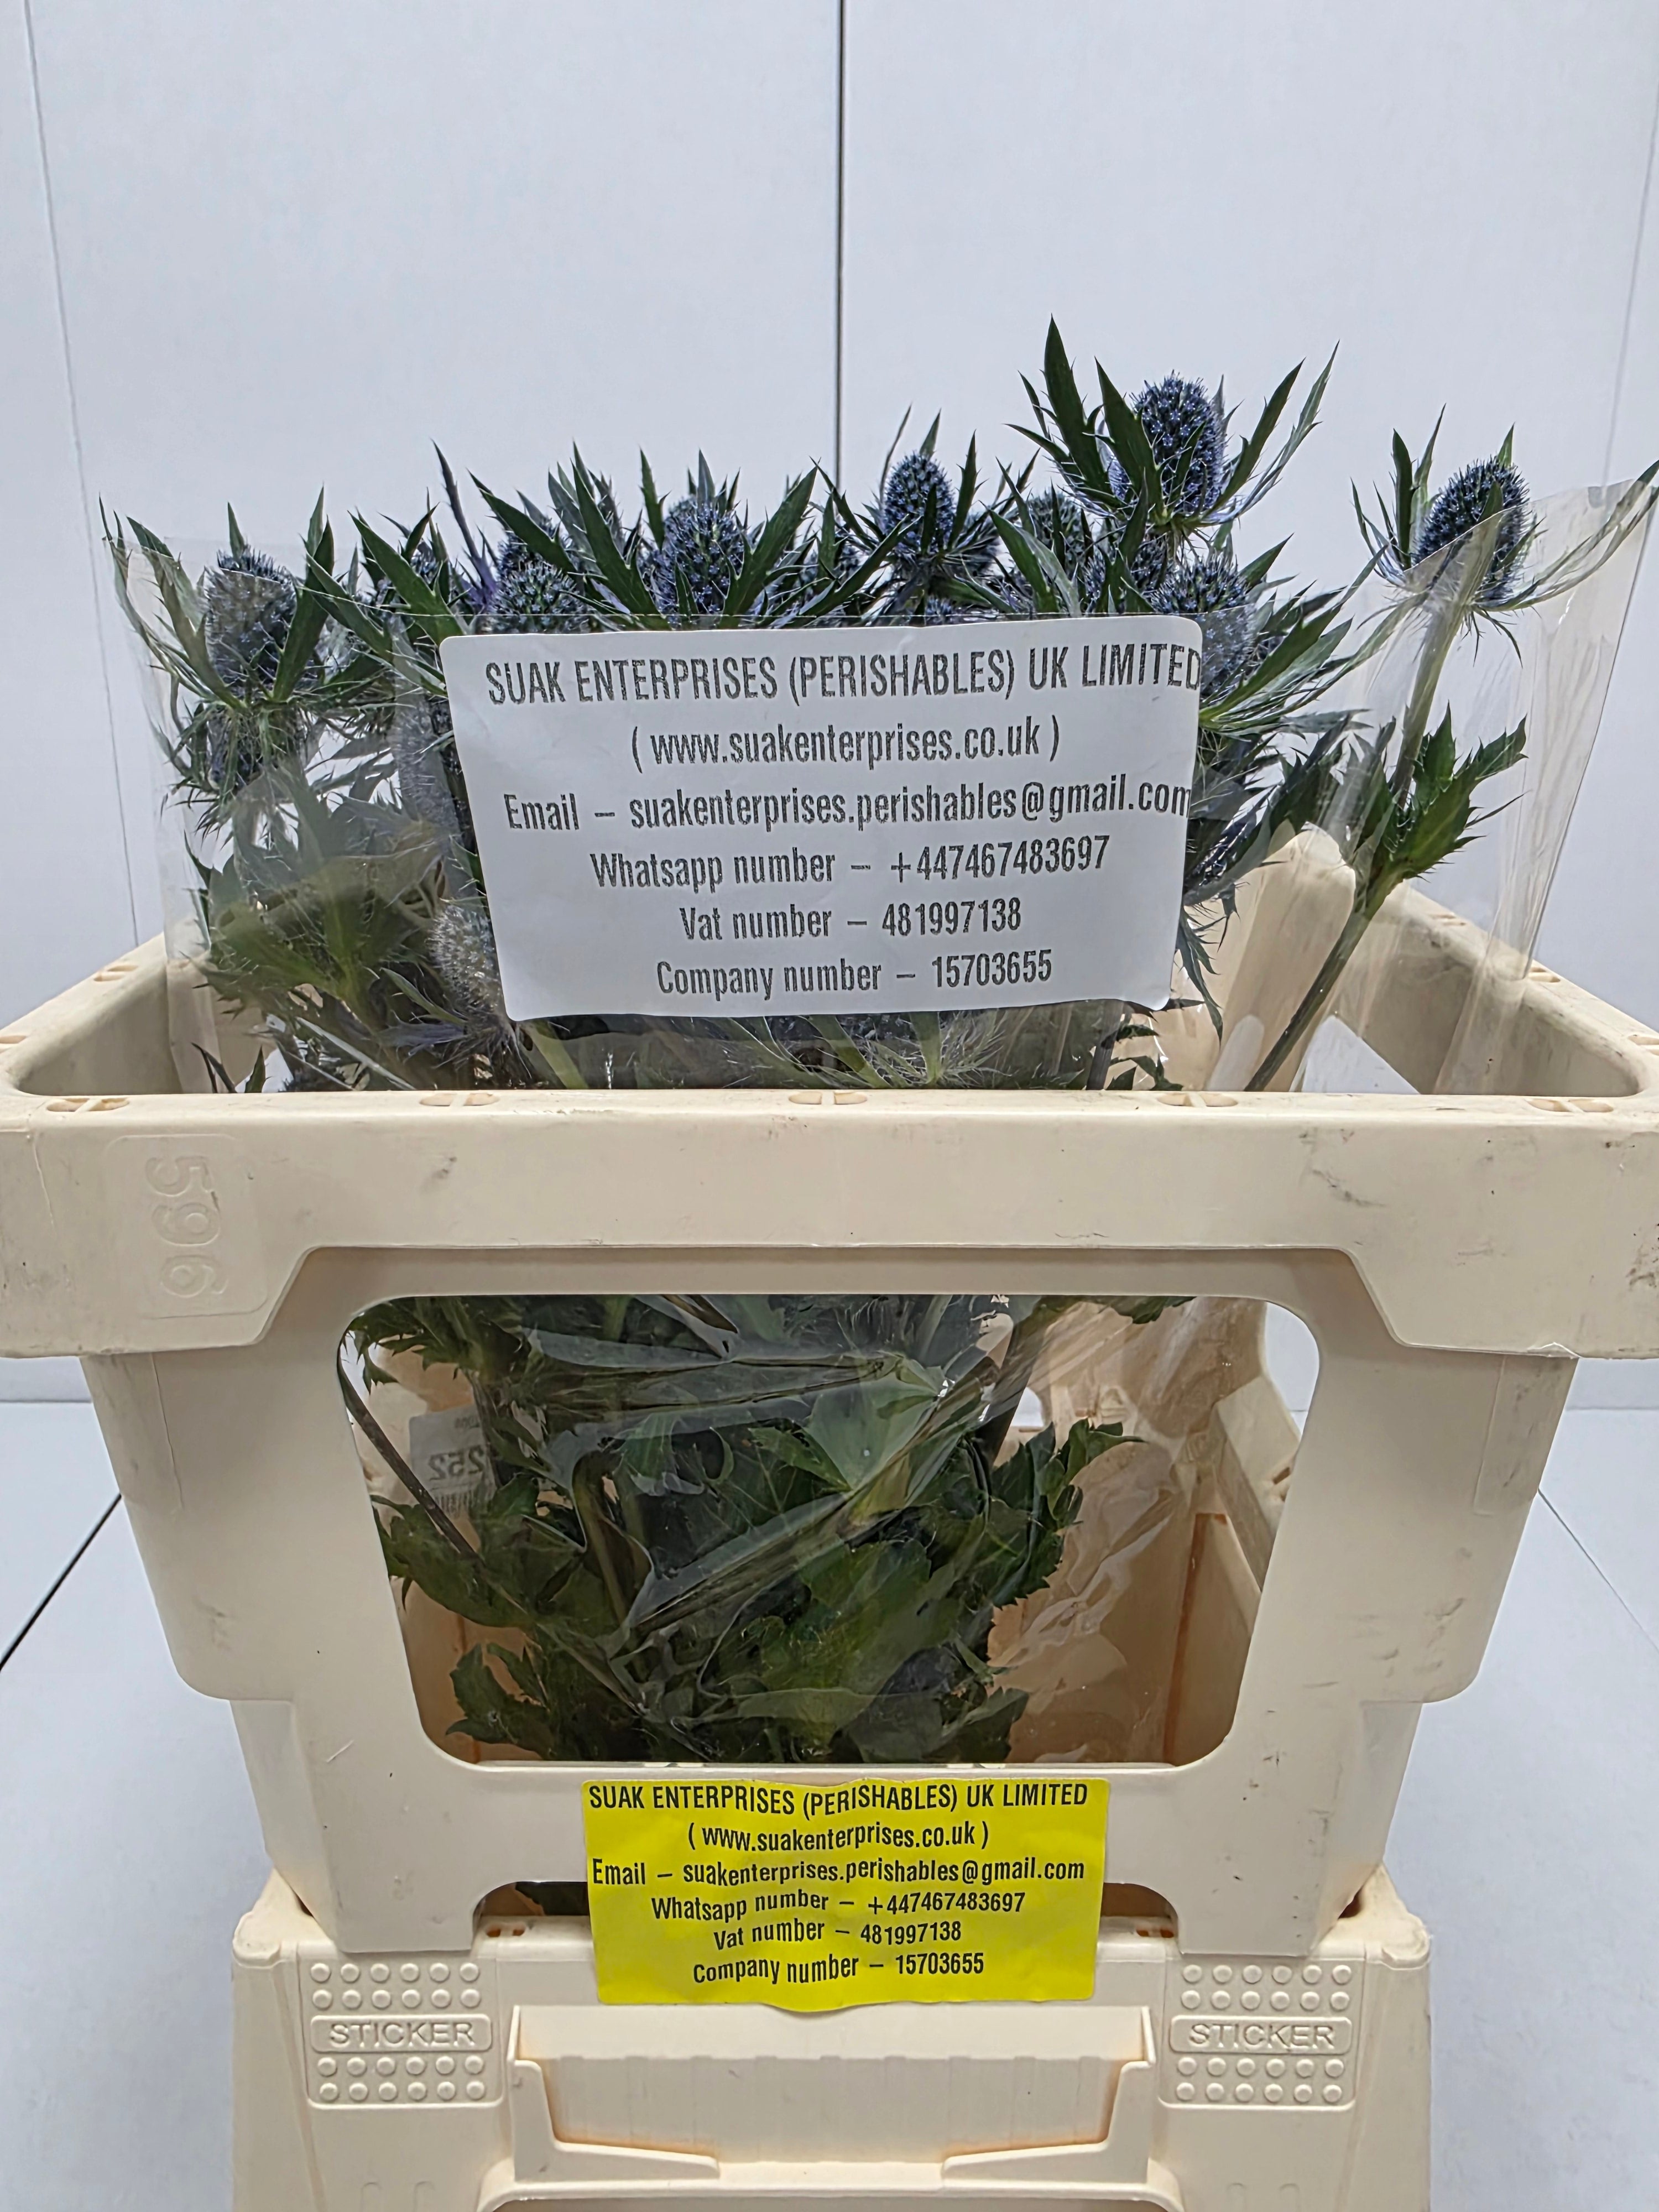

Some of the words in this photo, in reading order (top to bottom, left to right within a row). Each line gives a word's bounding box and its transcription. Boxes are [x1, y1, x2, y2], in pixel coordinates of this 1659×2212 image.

[486, 662, 565, 704] SUAK
[575, 657, 777, 701] ENTERPRISES
[790, 650, 1014, 706] (PERISHABLES)
[1030, 647, 1068, 690] UK
[1082, 643, 1200, 690] LIMITED
[650, 716, 1040, 770] www.suakenterprises.co.uk
[504, 794, 579, 830] Email
[590, 853, 722, 894] Whatsapp
[734, 847, 835, 884] number
[891, 836, 1109, 883] +447467483697
[680, 907, 722, 940] Vat
[733, 904, 831, 939] number
[883, 898, 1020, 936] 481997138
[658, 962, 773, 1001] Company
[784, 958, 881, 992] number
[932, 950, 1051, 987] 15703655
[589, 1786, 644, 1808] SUAK
[653, 1786, 794, 1814] ENTERPRISES
[804, 1784, 957, 1820] (PERISHABLES)
[967, 1784, 994, 1807] UK
[1004, 1784, 1087, 1806] LIMITED
[702, 1821, 974, 1851] www.suakenterprises.co.uk
[593, 1859, 645, 1885] Email
[684, 1857, 1084, 1886] suakenterprises.perishables@gmail.com
[651, 1897, 747, 1923] Whatsapp
[755, 1889, 828, 1911] number
[868, 1892, 1025, 1914] +447467483697
[714, 1928, 743, 1950] Vat
[753, 1919, 825, 1942] number
[861, 1921, 961, 1945] 481997138
[694, 1959, 779, 1984] Company
[787, 1954, 859, 1983] number
[896, 1953, 983, 1974] 15703655
[330, 2022, 474, 2047] STICKER
[1190, 2023, 1334, 2049] STICKER
